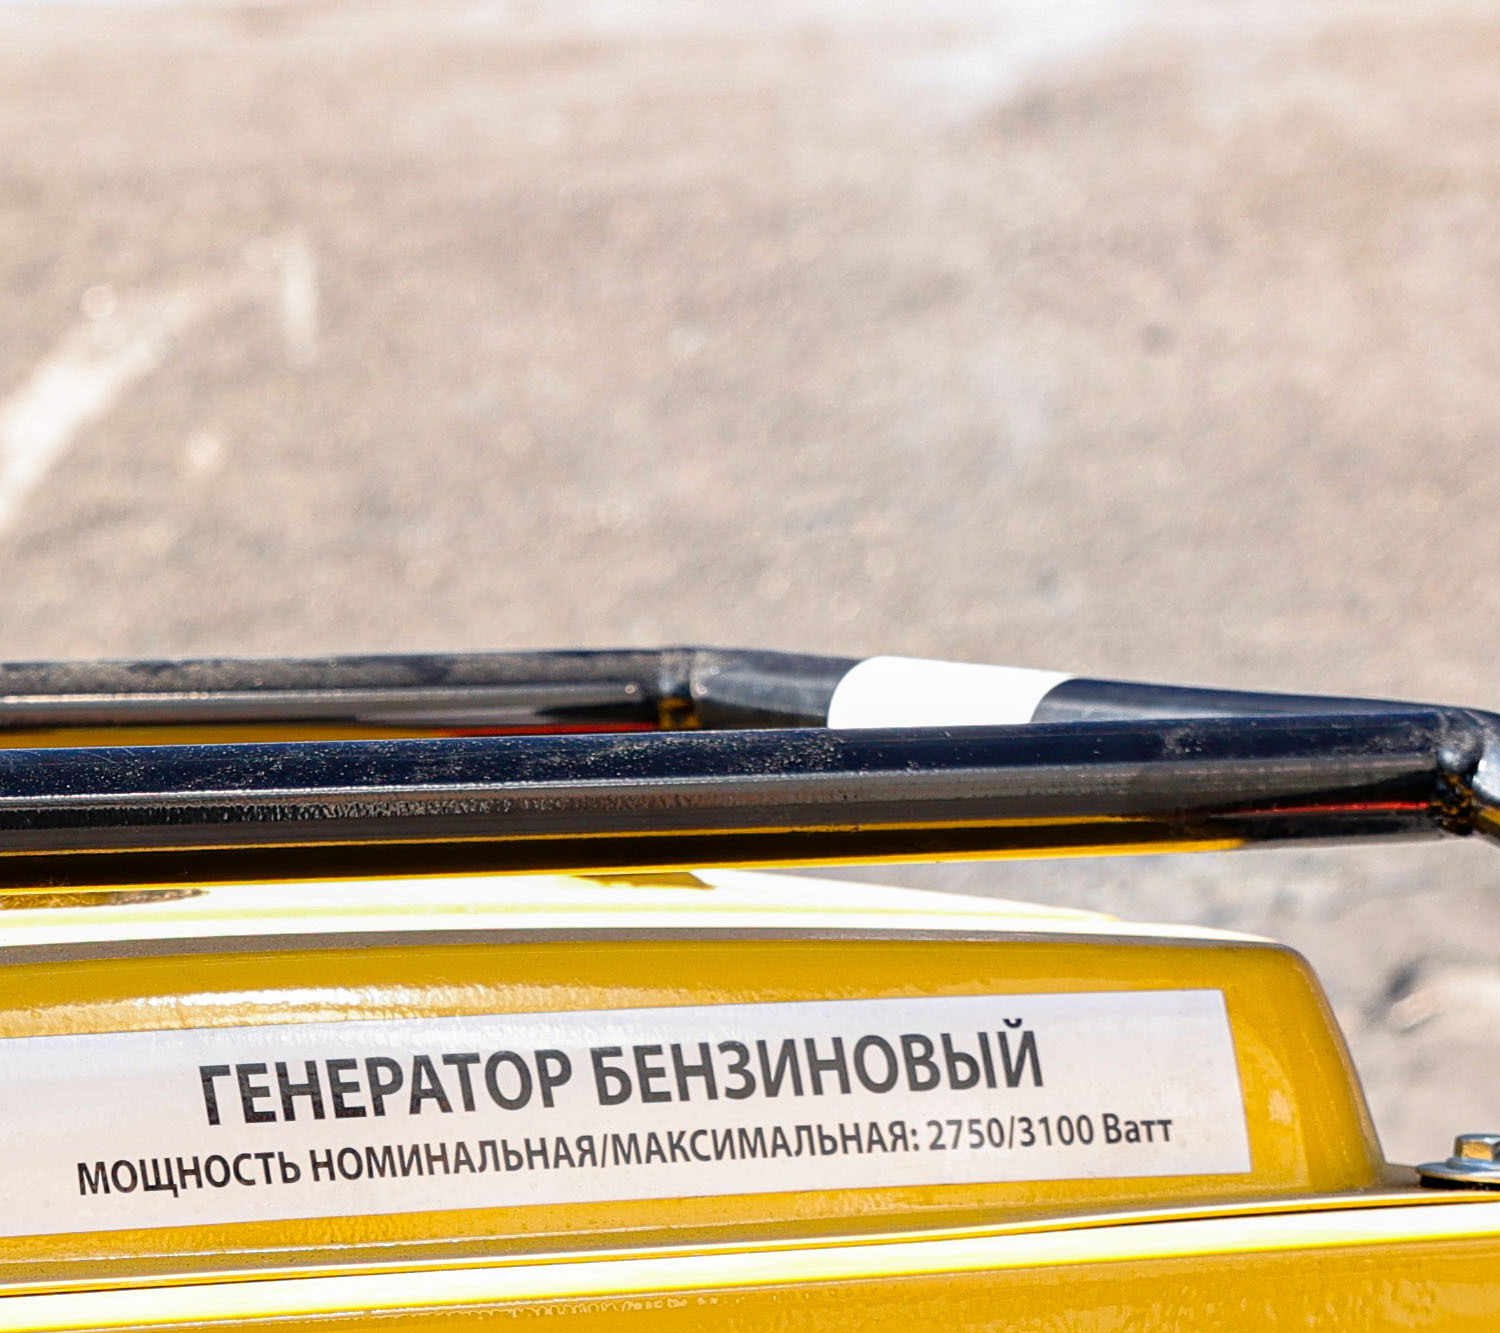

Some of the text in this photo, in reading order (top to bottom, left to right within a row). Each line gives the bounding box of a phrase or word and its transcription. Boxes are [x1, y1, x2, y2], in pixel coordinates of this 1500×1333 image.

[199, 1018, 1044, 1126] ГЕНЕРАТОР БЕНЗИНОВЫЙ
[77, 1112, 1174, 1199] МОЩНОСТЬ НОМИНАЛЬНАЯ/МАКСИМАЛЬНАЯ: 2750/3100 Ватт
